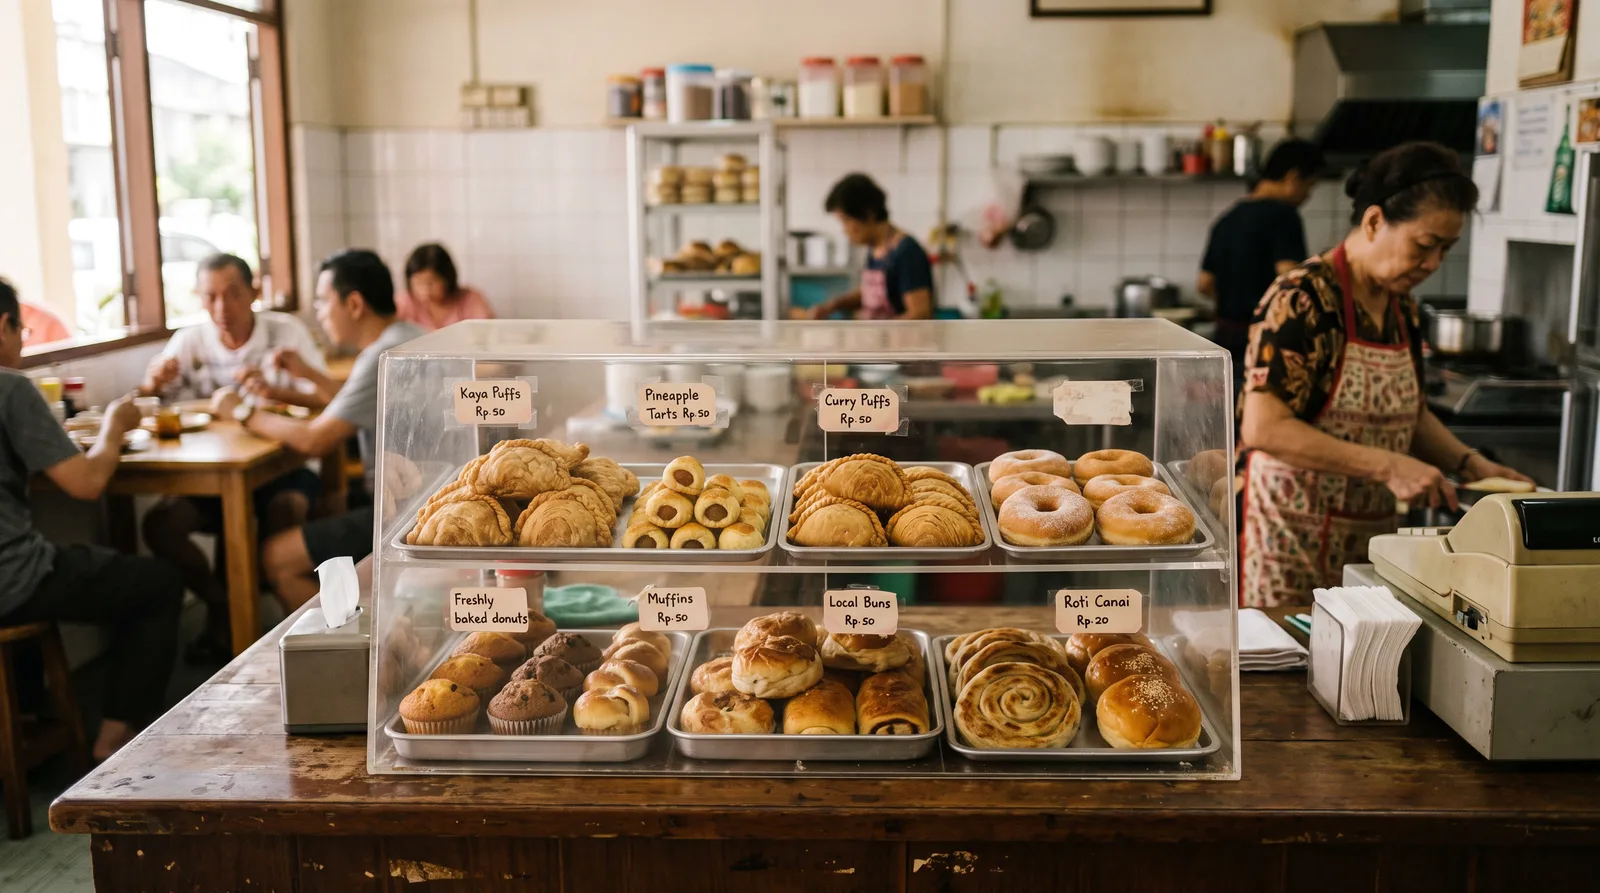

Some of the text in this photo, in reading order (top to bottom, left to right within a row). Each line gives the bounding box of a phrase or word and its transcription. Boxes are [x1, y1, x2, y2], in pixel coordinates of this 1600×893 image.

[460, 385, 521, 404] Kaya Puffs
[645, 388, 700, 406] Pineapple
[824, 392, 891, 412] Curry Puffs
[645, 407, 678, 420] Tarts
[454, 592, 495, 610] Freshly
[647, 592, 694, 608] Muffins
[829, 595, 891, 609] Local Buns
[1063, 594, 1130, 609] Roti Canai
[454, 610, 528, 625] baked donuts
